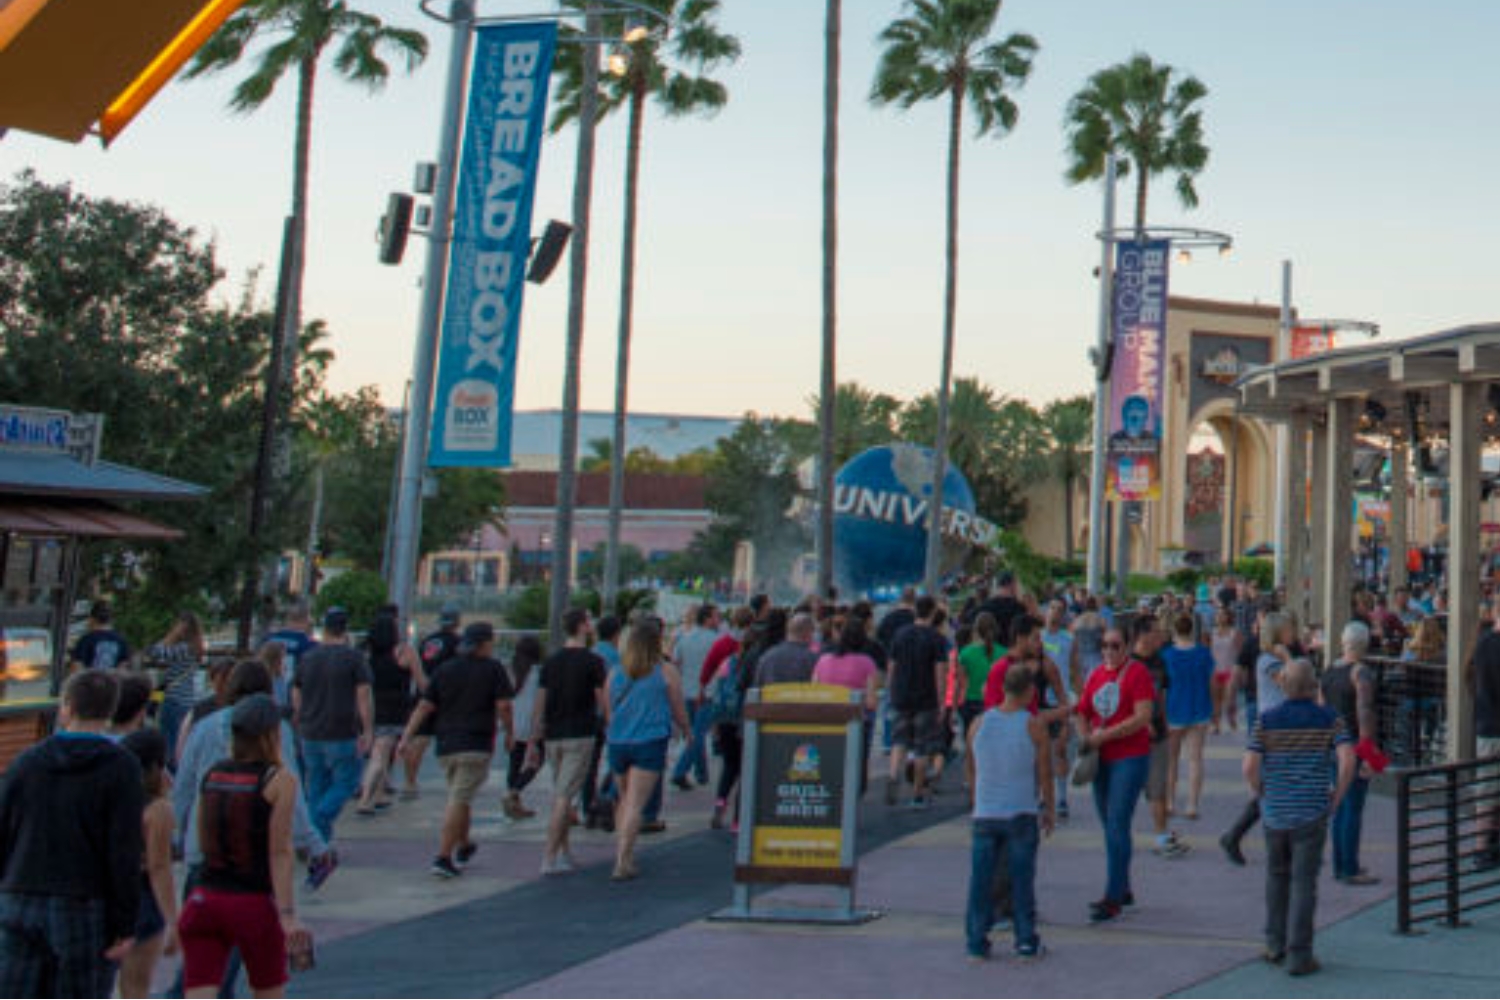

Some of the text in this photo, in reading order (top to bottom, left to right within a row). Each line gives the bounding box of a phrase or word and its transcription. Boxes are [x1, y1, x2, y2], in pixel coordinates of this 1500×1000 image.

[482, 40, 541, 240] BREAD
[464, 251, 512, 373] BOX
[1118, 251, 1141, 349] GROUP
[1140, 250, 1164, 323] BLUE
